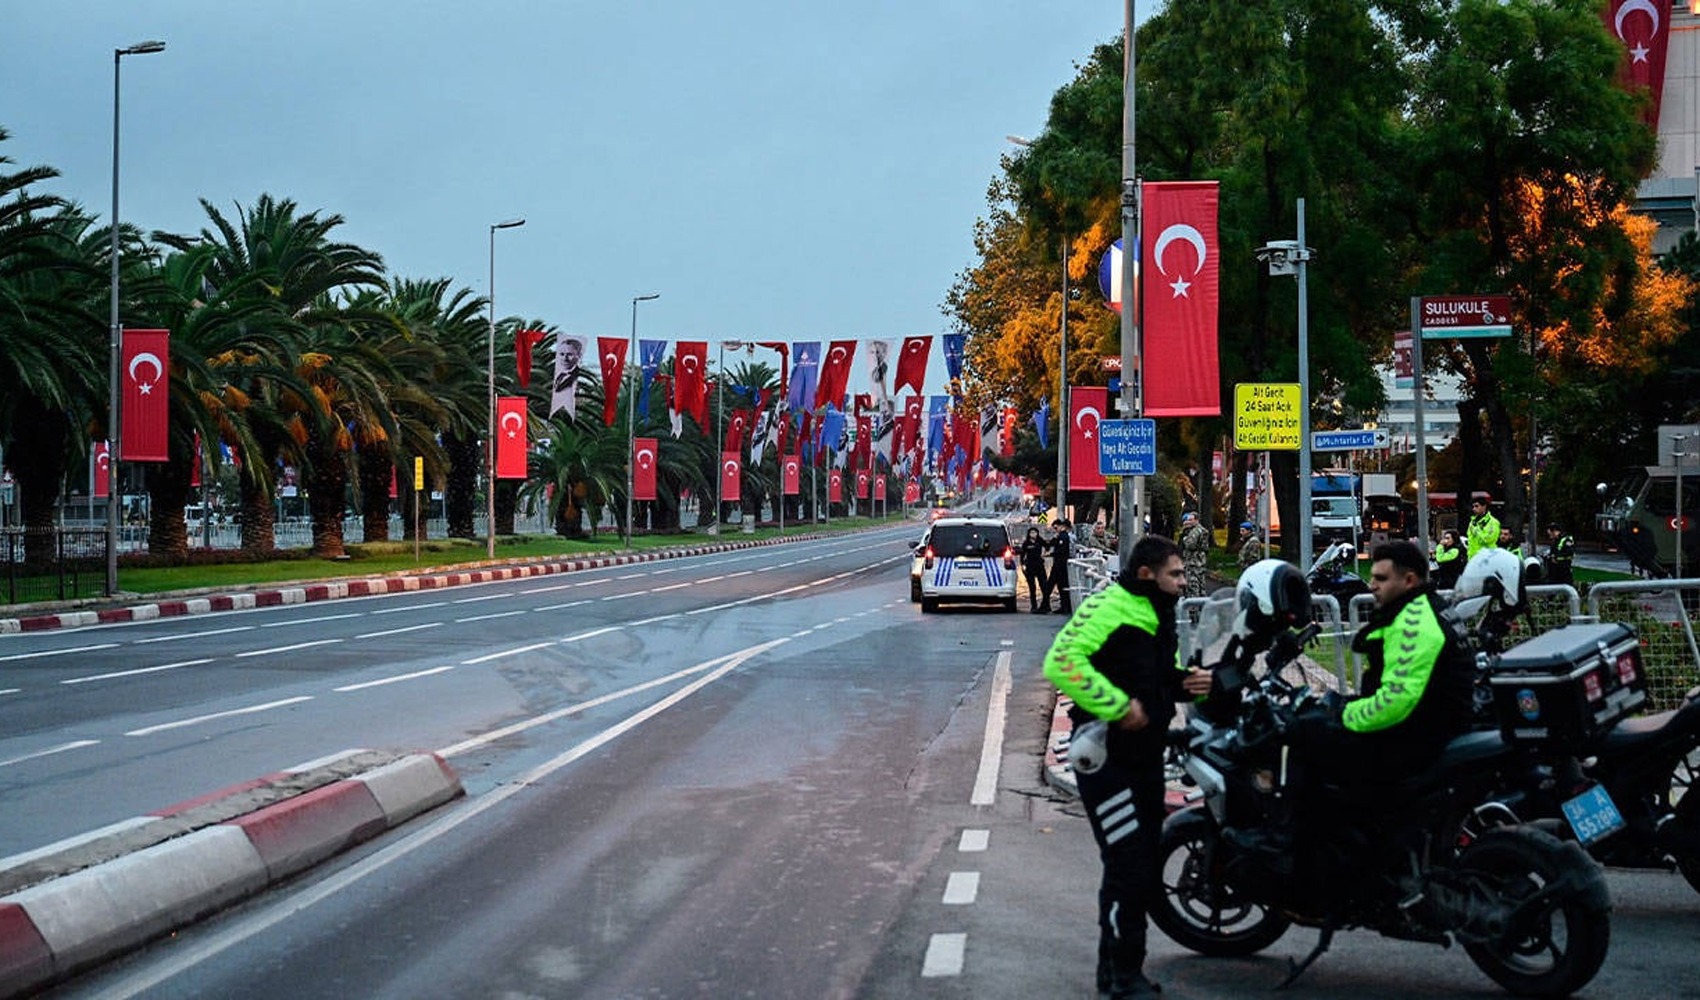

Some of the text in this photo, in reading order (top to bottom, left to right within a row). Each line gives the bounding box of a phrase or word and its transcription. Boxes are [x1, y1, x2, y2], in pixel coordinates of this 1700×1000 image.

[1425, 301, 1489, 315] SULUKULE
[1245, 400, 1256, 412] 24
[1257, 400, 1274, 412] Saat
